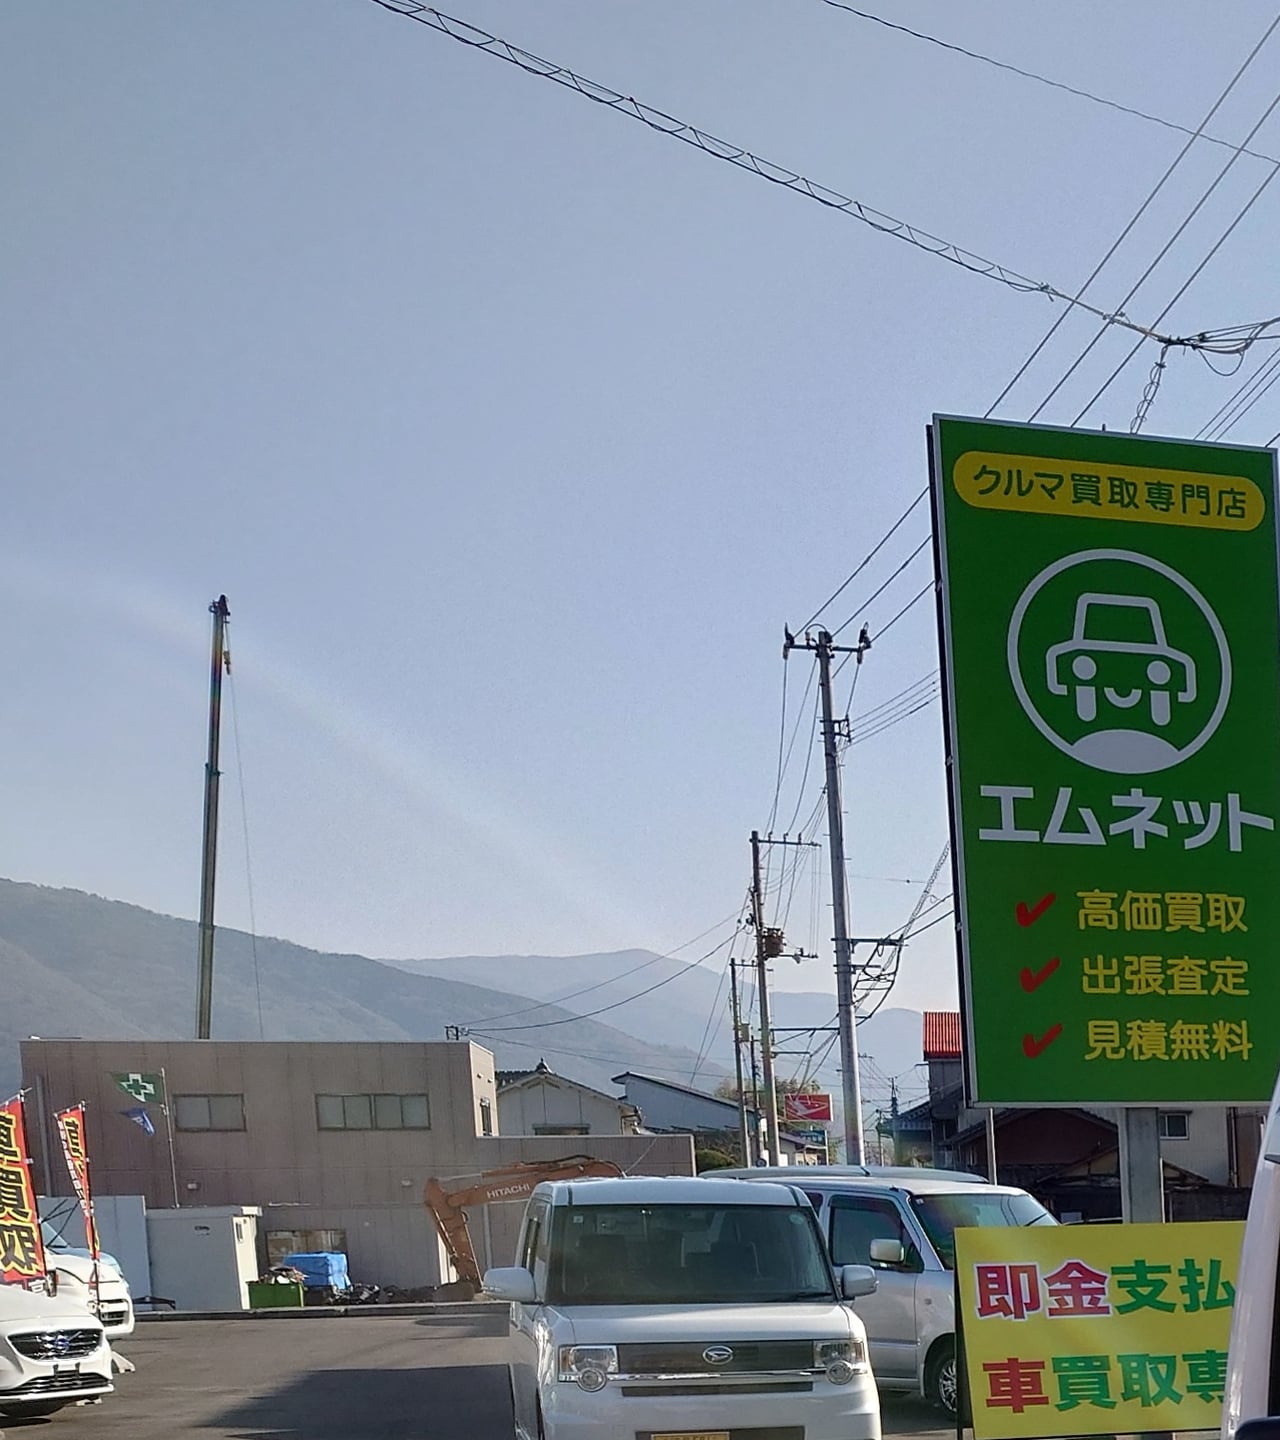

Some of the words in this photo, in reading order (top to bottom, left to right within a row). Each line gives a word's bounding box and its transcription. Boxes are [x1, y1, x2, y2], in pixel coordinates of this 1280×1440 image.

[973, 464, 1247, 519] クルマ買取専門店
[978, 785, 1275, 852] エムネット
[1076, 889, 1249, 932] 高価買取
[1081, 955, 1250, 995] 出張査定
[1084, 1019, 1253, 1060] 見積無料
[486, 1183, 530, 1199] HITACHI
[974, 1258, 1236, 1320] 即金支払
